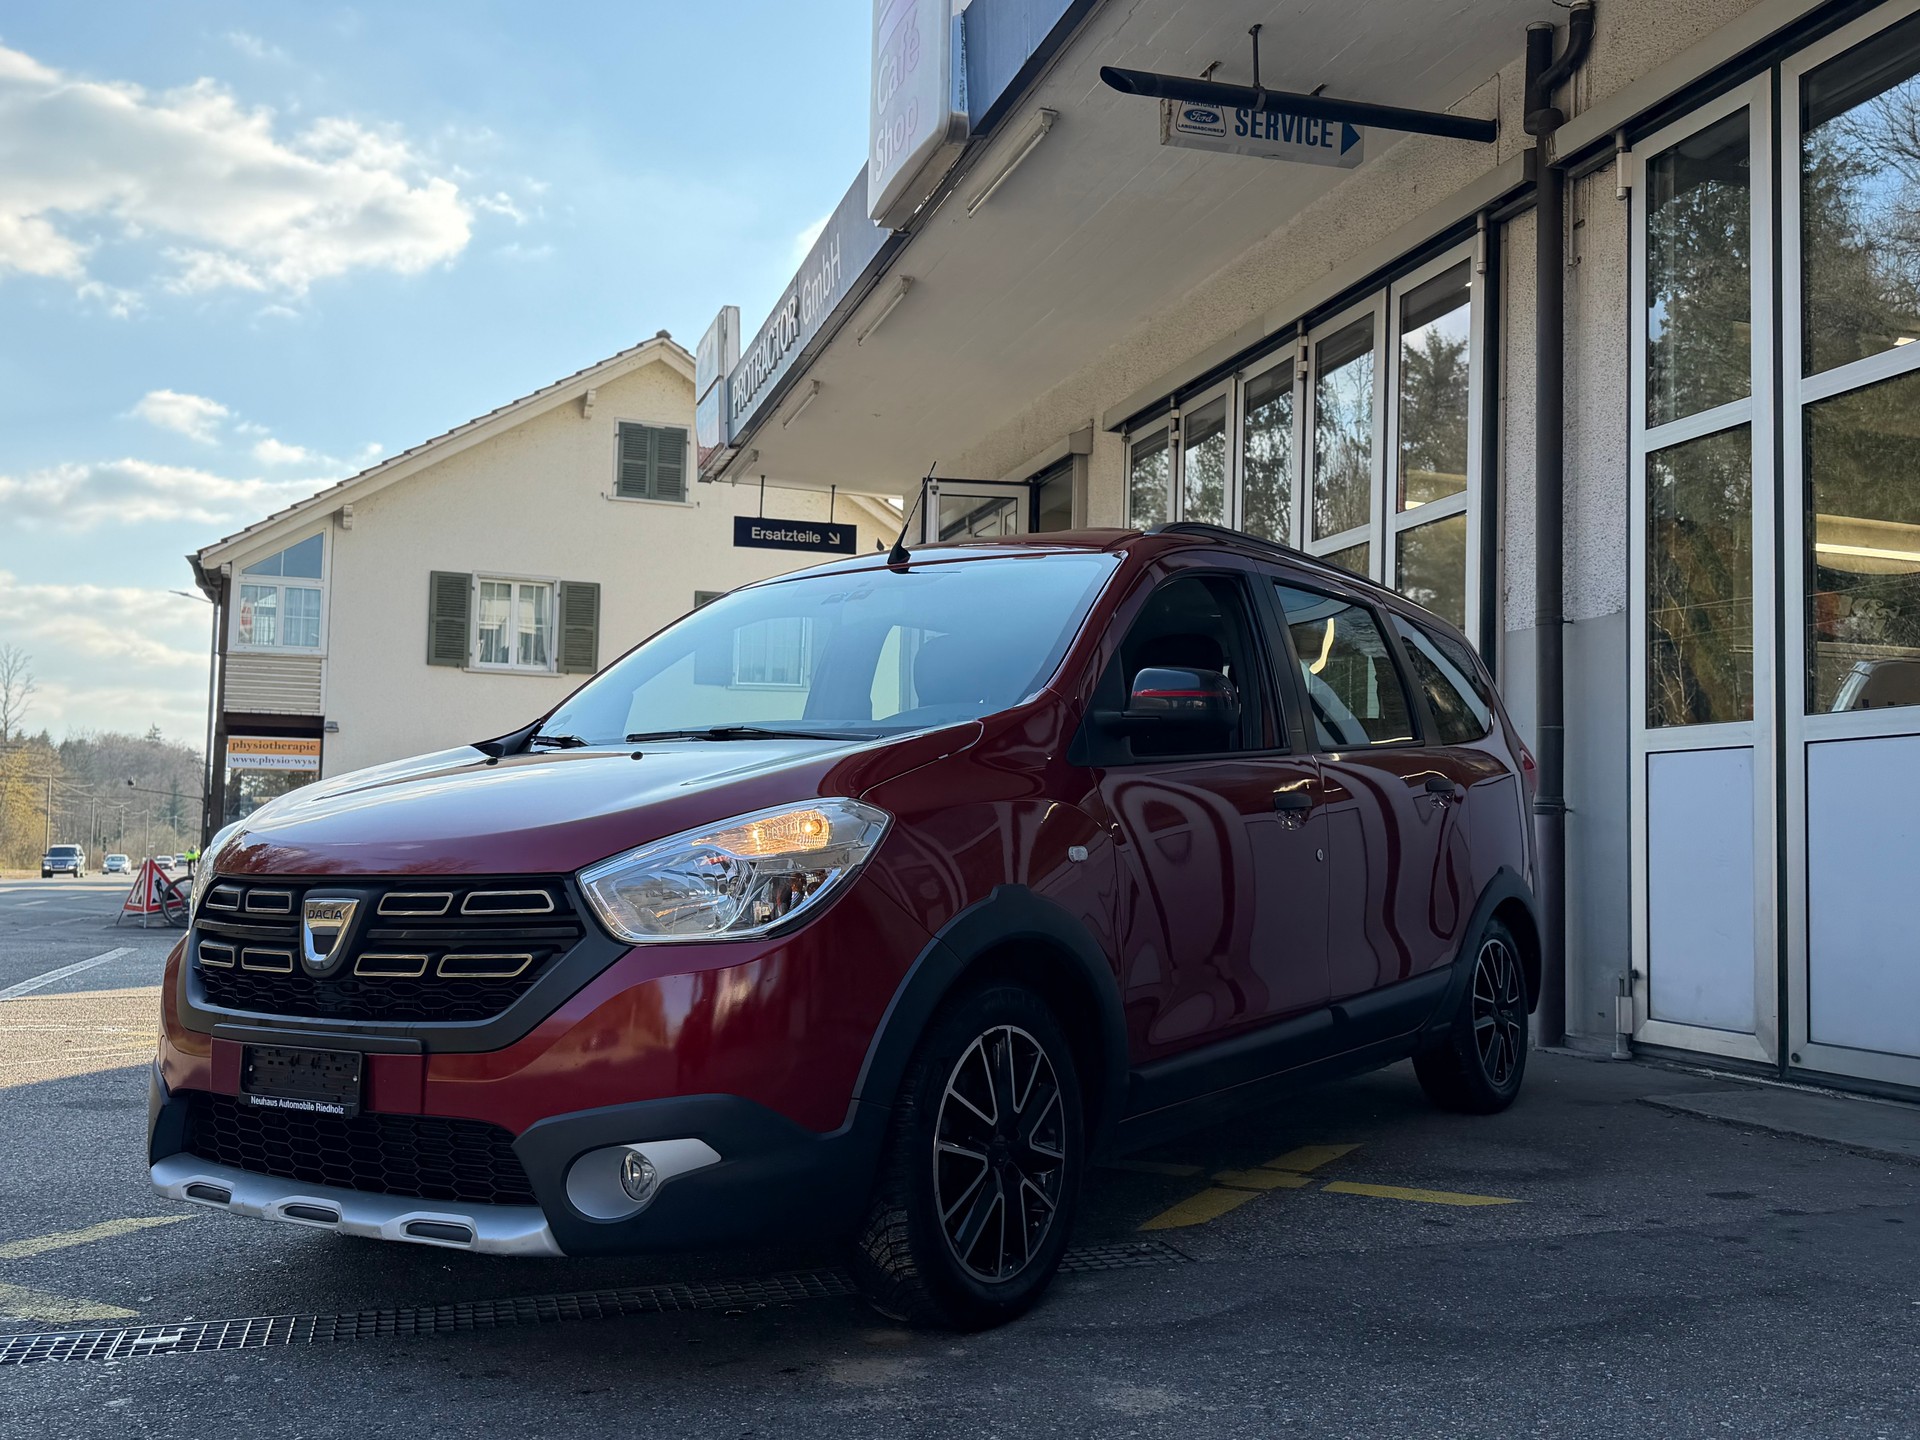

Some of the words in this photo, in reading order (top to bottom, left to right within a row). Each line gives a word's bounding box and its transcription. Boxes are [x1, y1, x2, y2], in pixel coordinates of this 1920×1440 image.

[1190, 110, 1214, 122] Ford
[1235, 108, 1334, 147] SERVICE
[733, 295, 799, 419] PROTRACTOR
[802, 233, 842, 325] GmbH
[751, 526, 821, 544] Ersatzteile
[232, 740, 316, 753] physiotherapie
[308, 909, 343, 919] DACIA
[250, 1096, 278, 1107] Neuhaus
[278, 1099, 315, 1112] Automobile
[315, 1102, 344, 1115] Riedholz
